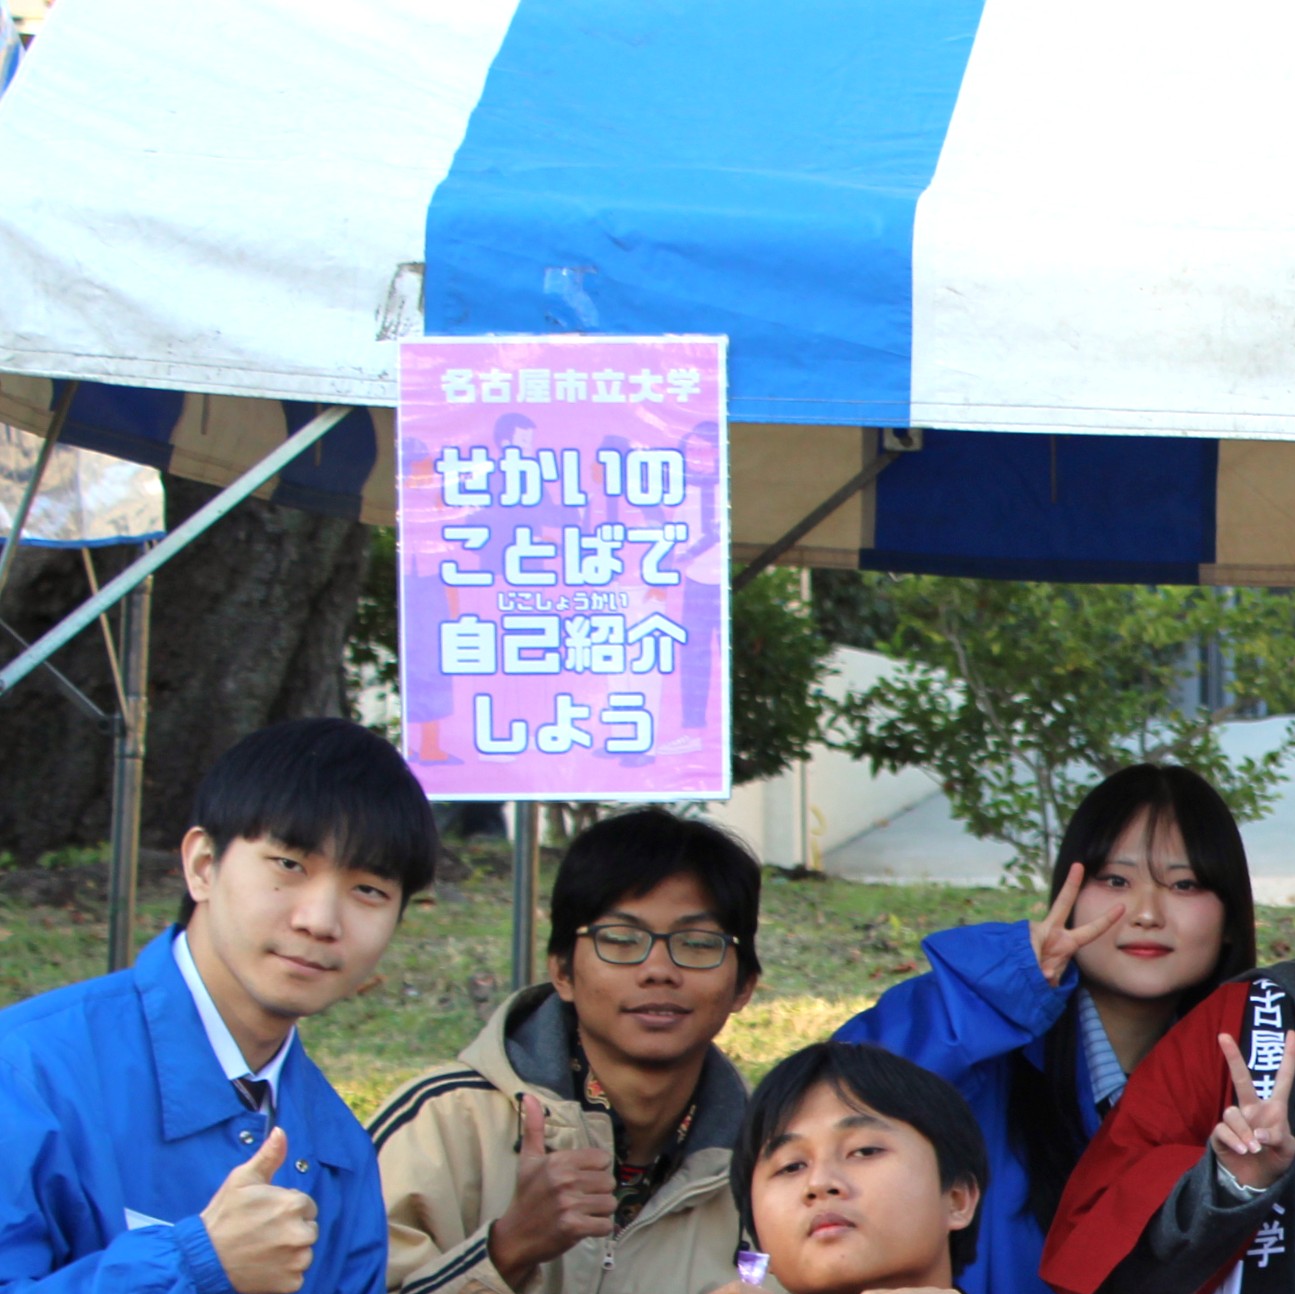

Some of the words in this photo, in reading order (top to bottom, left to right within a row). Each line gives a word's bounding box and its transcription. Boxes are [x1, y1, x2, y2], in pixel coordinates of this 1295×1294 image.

[440, 368, 701, 403] 名古屋市立大学
[436, 447, 686, 507] せかいの
[440, 523, 688, 587] ことばで
[498, 592, 629, 612] じこしょうかい
[440, 614, 687, 675] 自己紹介
[474, 693, 654, 754] しよう
